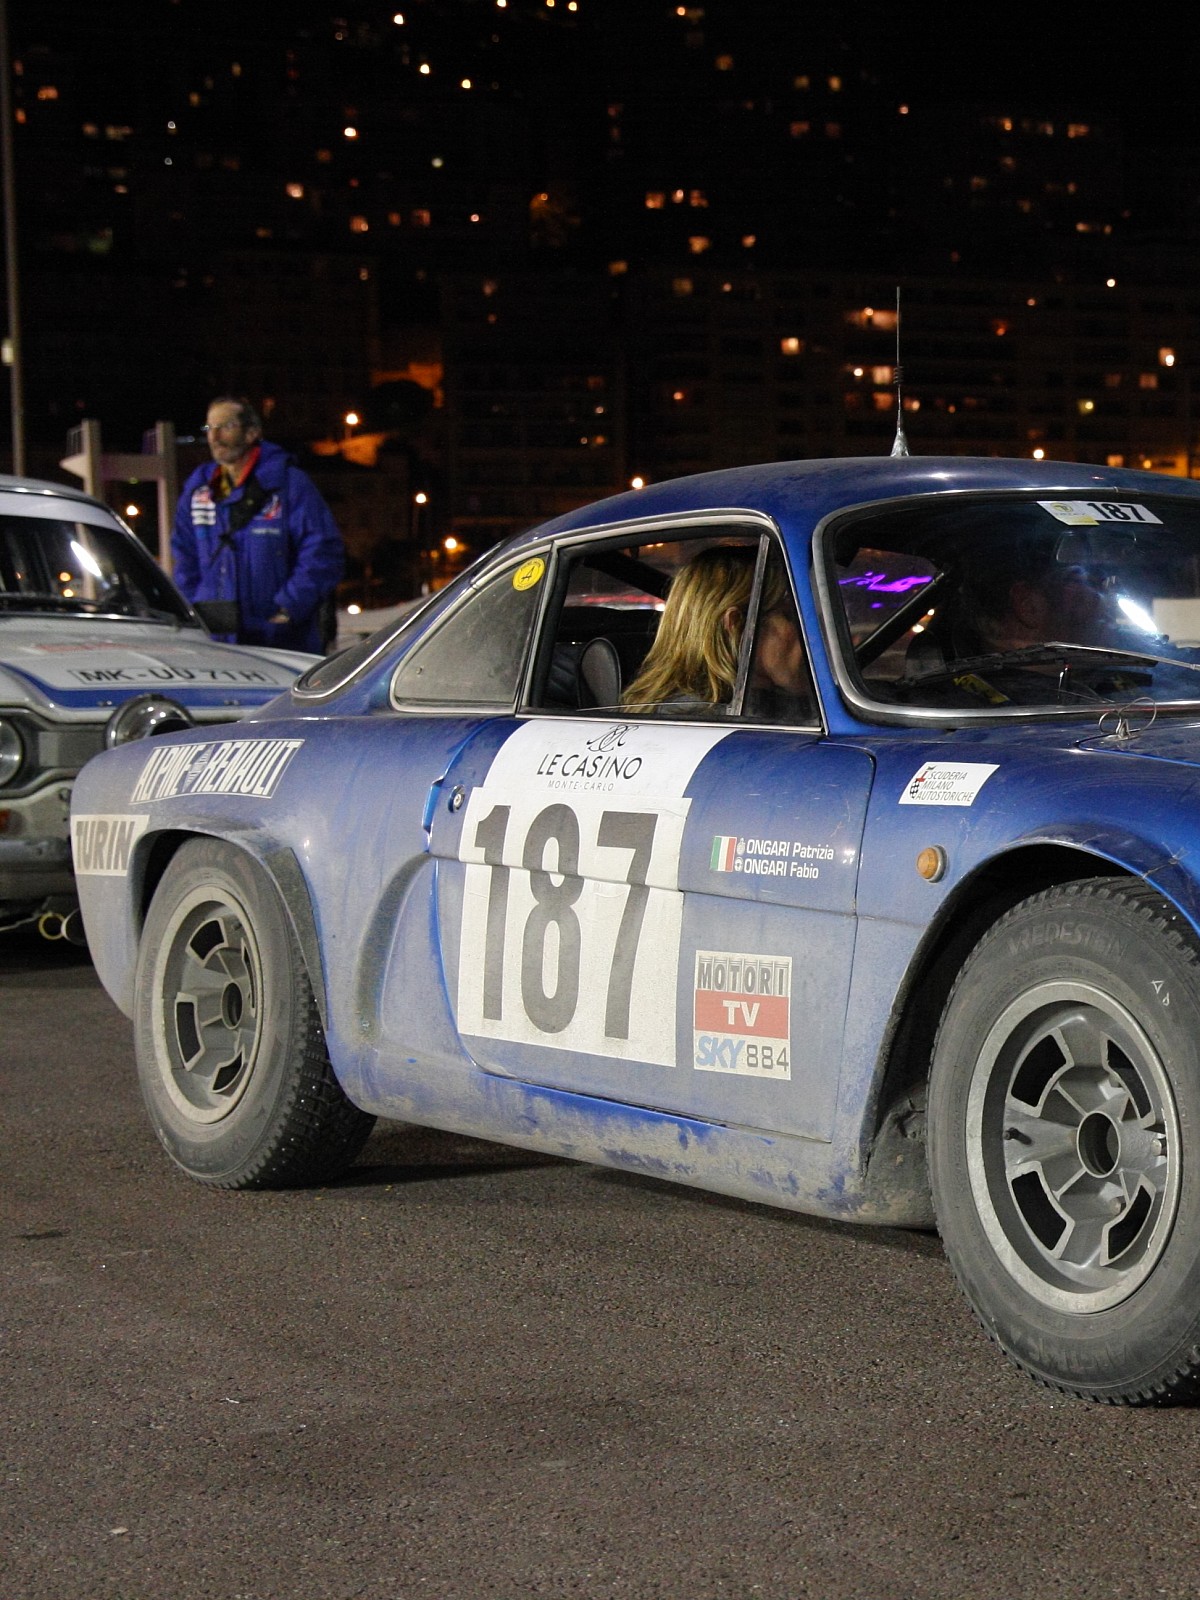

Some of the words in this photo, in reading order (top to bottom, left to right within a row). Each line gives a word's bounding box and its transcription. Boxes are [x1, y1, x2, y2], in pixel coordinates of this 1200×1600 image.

[1086, 502, 1146, 521] 187
[130, 744, 201, 802] ALPINE
[190, 740, 300, 796] RENAULT
[537, 753, 563, 776] LE
[561, 754, 643, 780] CASINO
[927, 771, 968, 781] SCUDERIA
[547, 780, 615, 792] MONTE-CARLO
[916, 791, 974, 801] AUTOSTORICHE
[920, 781, 954, 791] MILANO
[75, 820, 136, 871] TURIN
[746, 839, 790, 857] ONGARI
[792, 842, 835, 860] Patrizia
[743, 858, 788, 876] ONGARI
[789, 862, 819, 879] Fabio
[474, 803, 659, 1040] 187
[697, 962, 784, 996] MOTORI
[722, 999, 760, 1027] TV
[695, 1035, 746, 1069] SKY
[746, 1044, 789, 1072] 884
